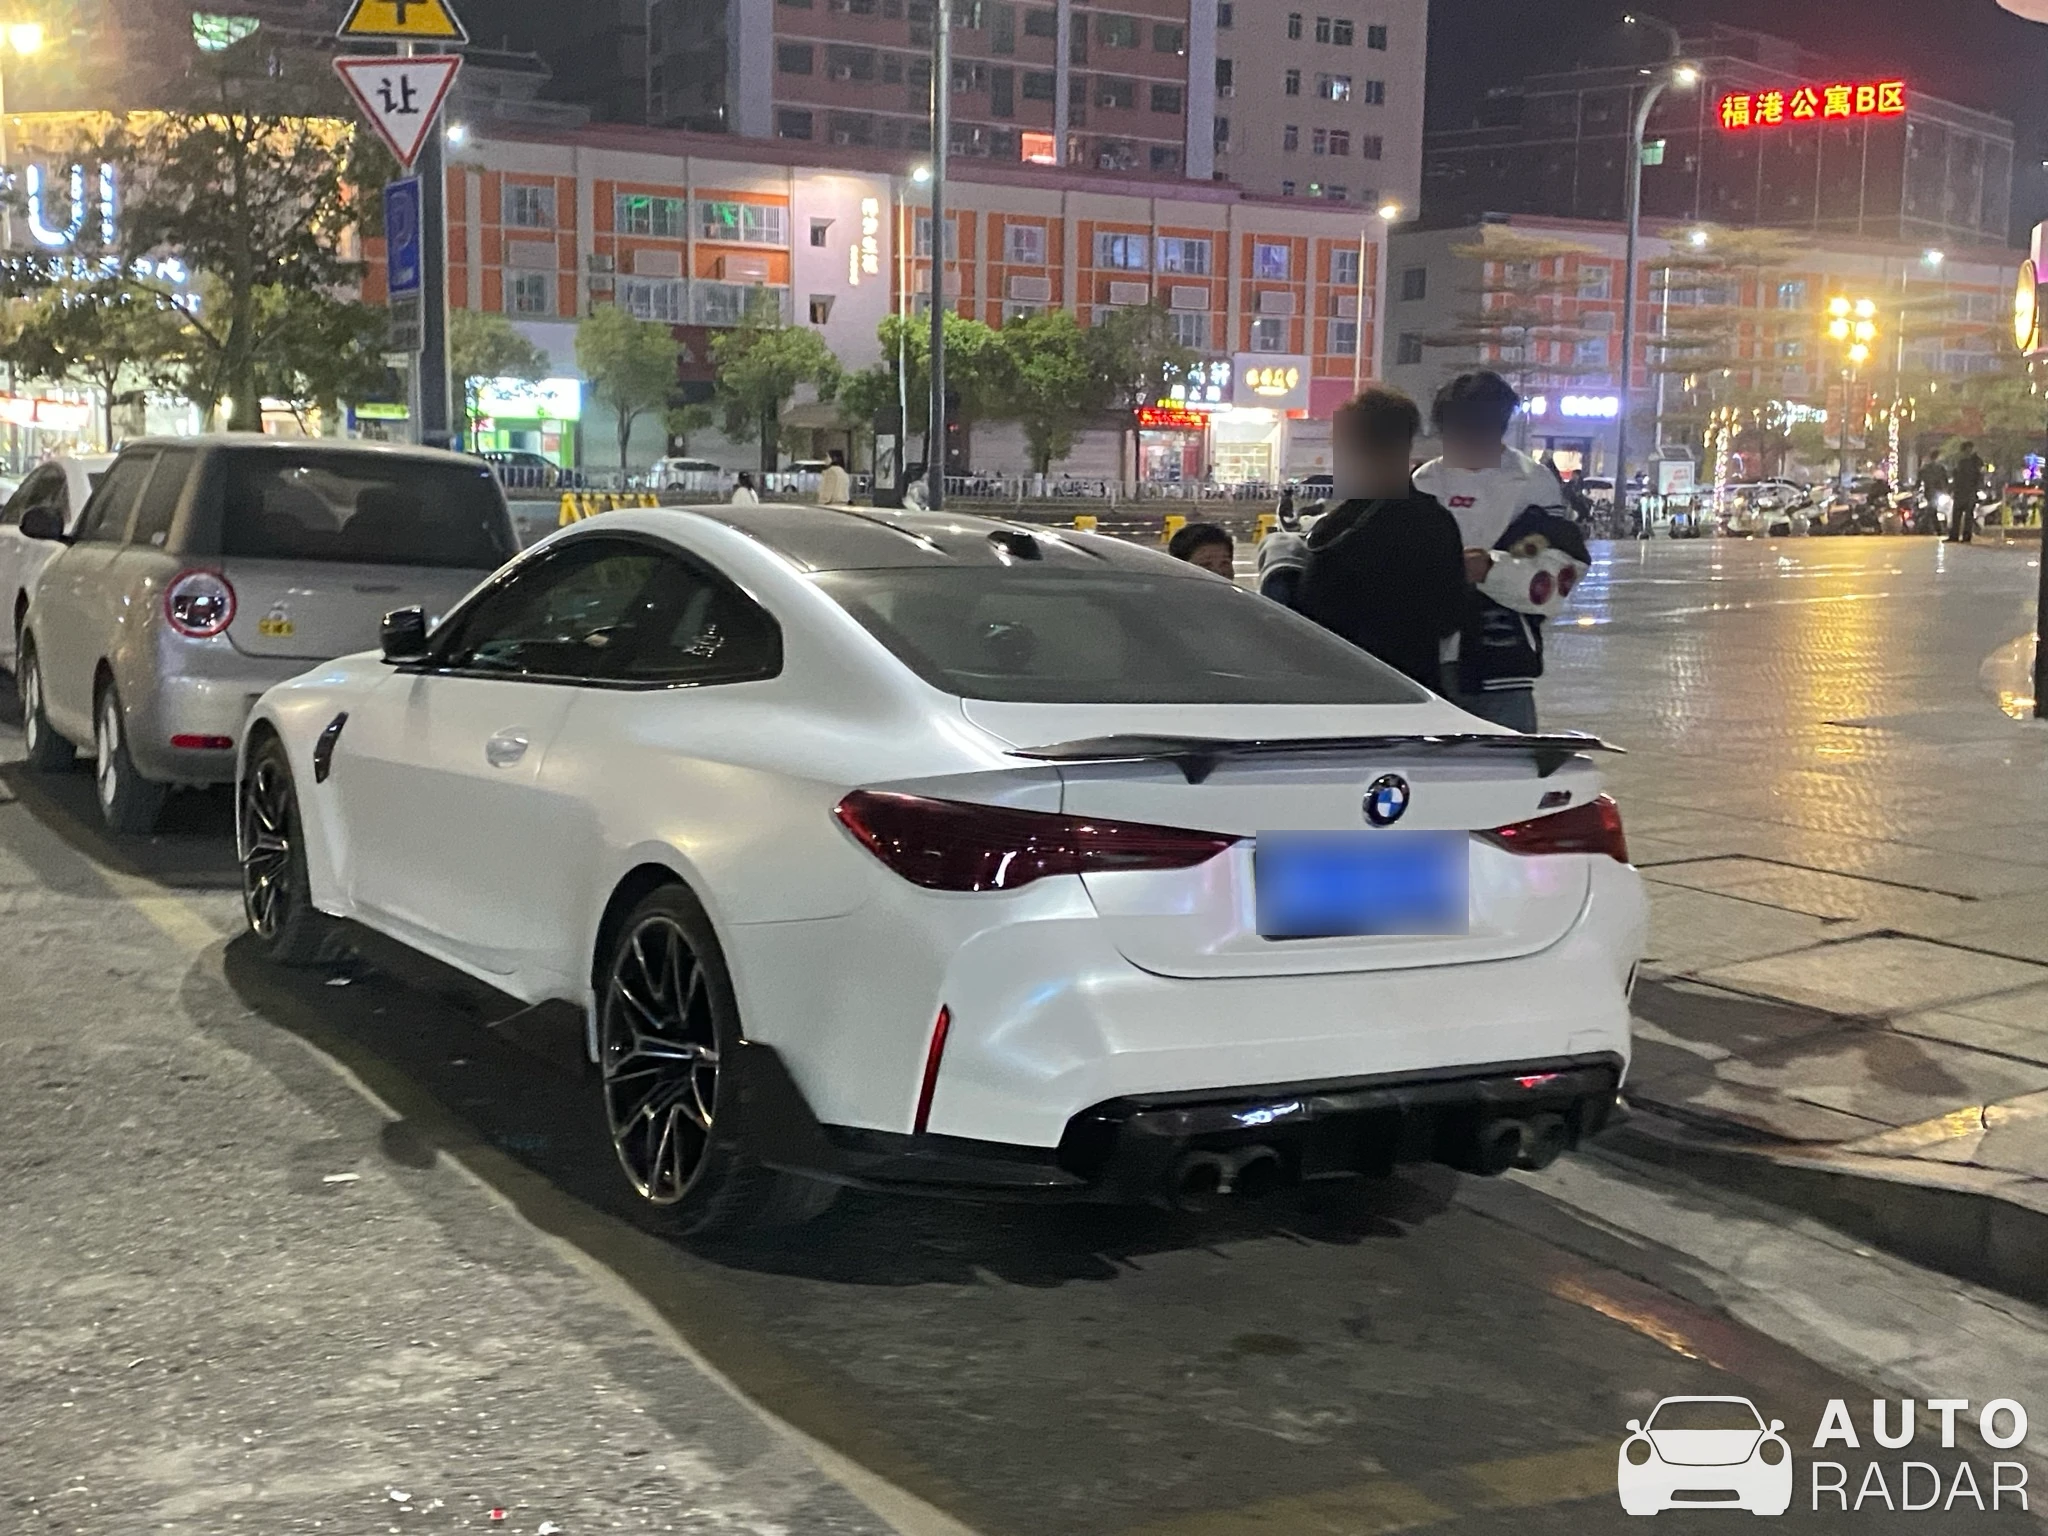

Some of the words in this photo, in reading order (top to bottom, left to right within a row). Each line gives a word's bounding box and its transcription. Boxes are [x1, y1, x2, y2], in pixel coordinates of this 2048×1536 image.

[377, 74, 419, 113] 让
[1722, 81, 1905, 128] 福港公寓B区
[0, 163, 115, 246] UI
